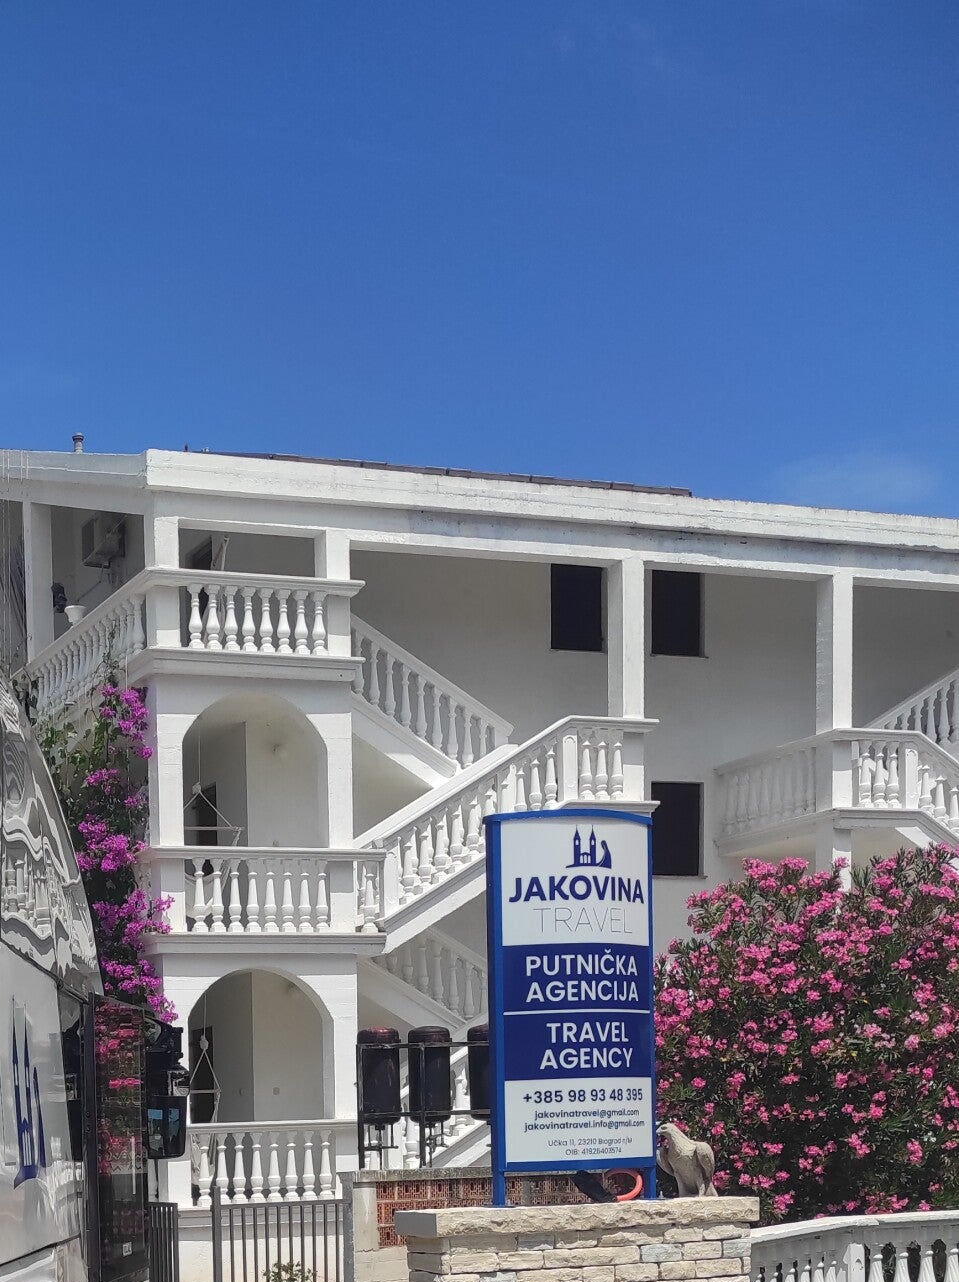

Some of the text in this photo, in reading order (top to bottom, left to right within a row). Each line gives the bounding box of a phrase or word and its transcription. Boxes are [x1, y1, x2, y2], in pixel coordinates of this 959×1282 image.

[508, 875, 644, 904] JAKOVINA
[533, 907, 633, 934] TRAVEL
[525, 949, 638, 977] PUTNIČKA
[526, 980, 639, 1003] AGENCIJA
[546, 1022, 629, 1044] TRAVEL
[540, 1047, 633, 1070] AGENCY
[523, 1088, 643, 1104] +385 98 93 48 395
[534, 1108, 640, 1120] jakovinatravel@gmail.com
[524, 1119, 644, 1133] jakovinatravel.info@gmail.com
[548, 1139, 568, 1147] Učka
[577, 1138, 597, 1146] 23210
